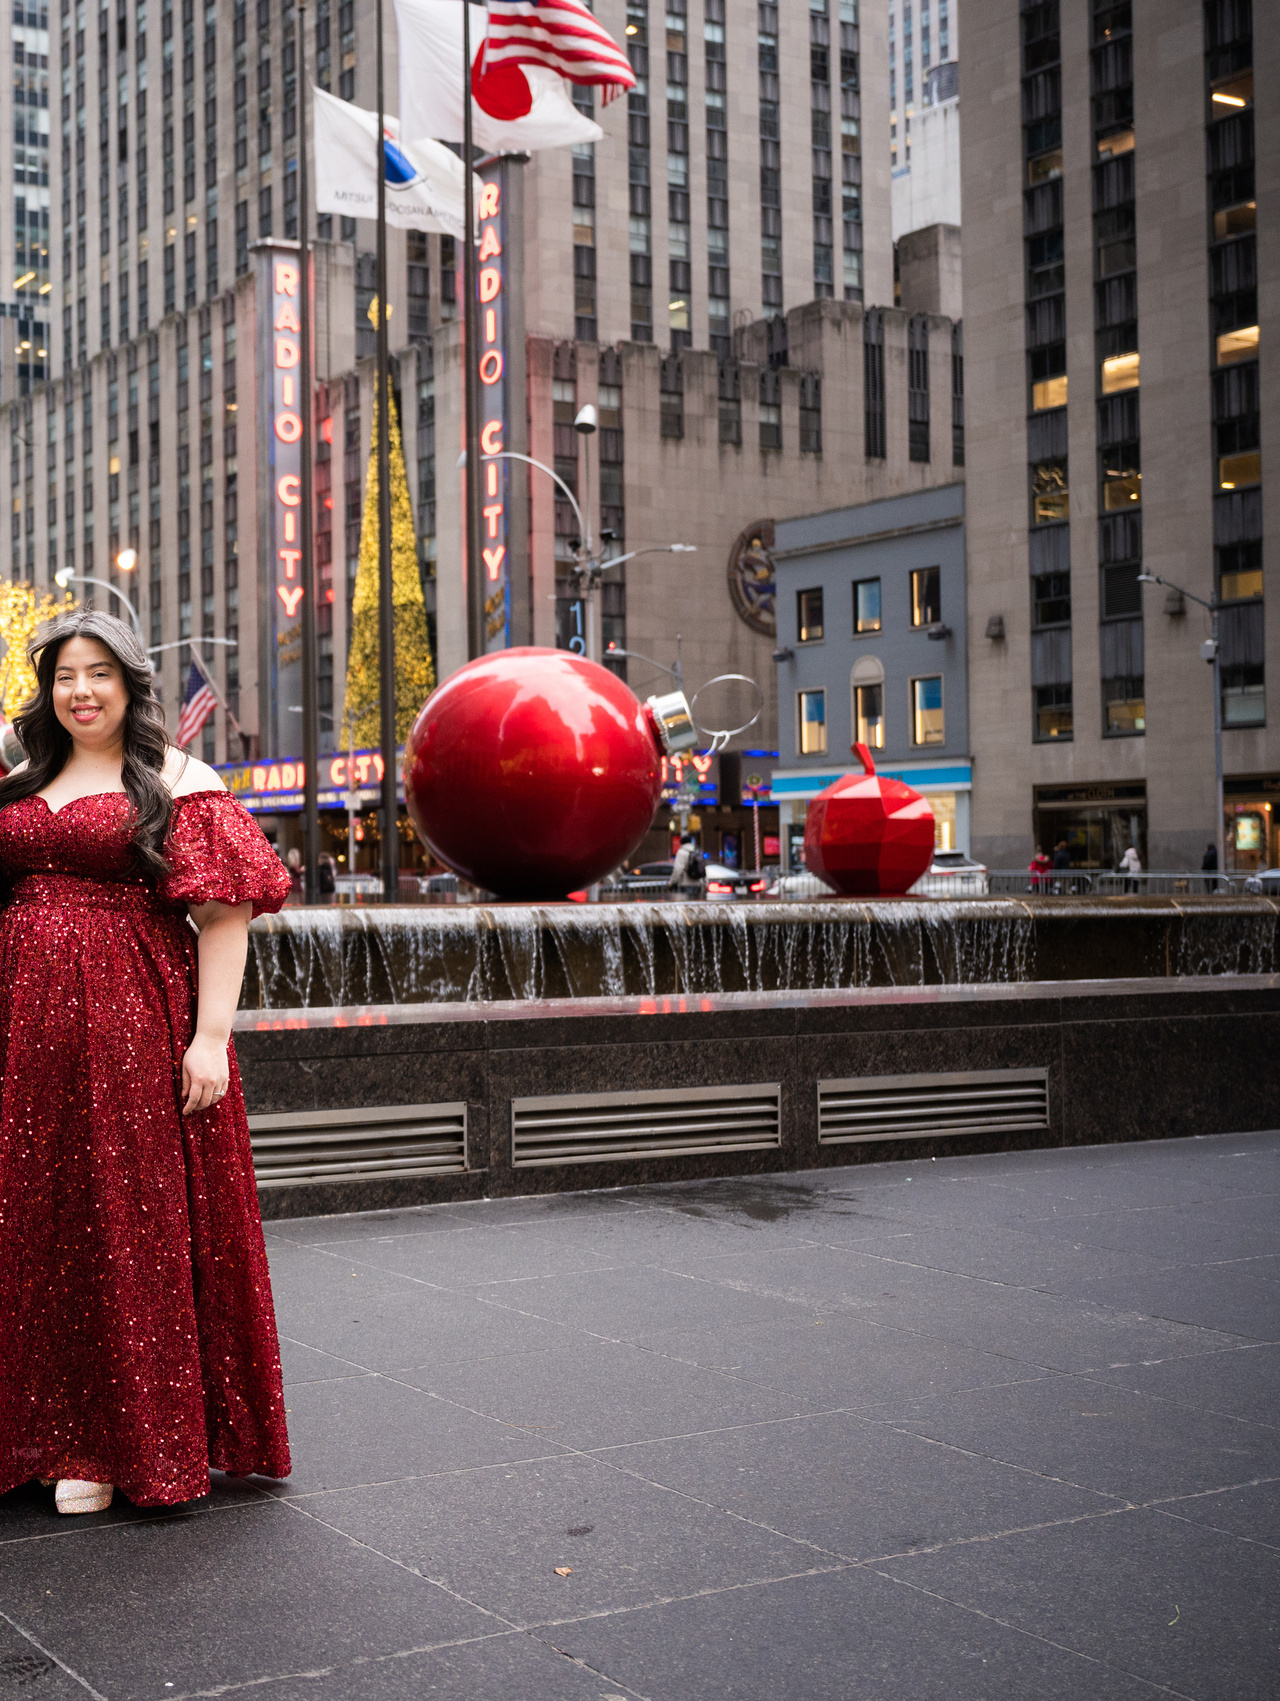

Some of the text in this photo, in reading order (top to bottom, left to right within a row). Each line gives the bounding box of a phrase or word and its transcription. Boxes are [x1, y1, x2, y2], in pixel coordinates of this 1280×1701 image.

[275, 263, 303, 443] RADIO
[479, 183, 503, 384] RADIO
[277, 474, 304, 617] CITY
[481, 420, 505, 581] CITY
[252, 763, 305, 792] RADI
